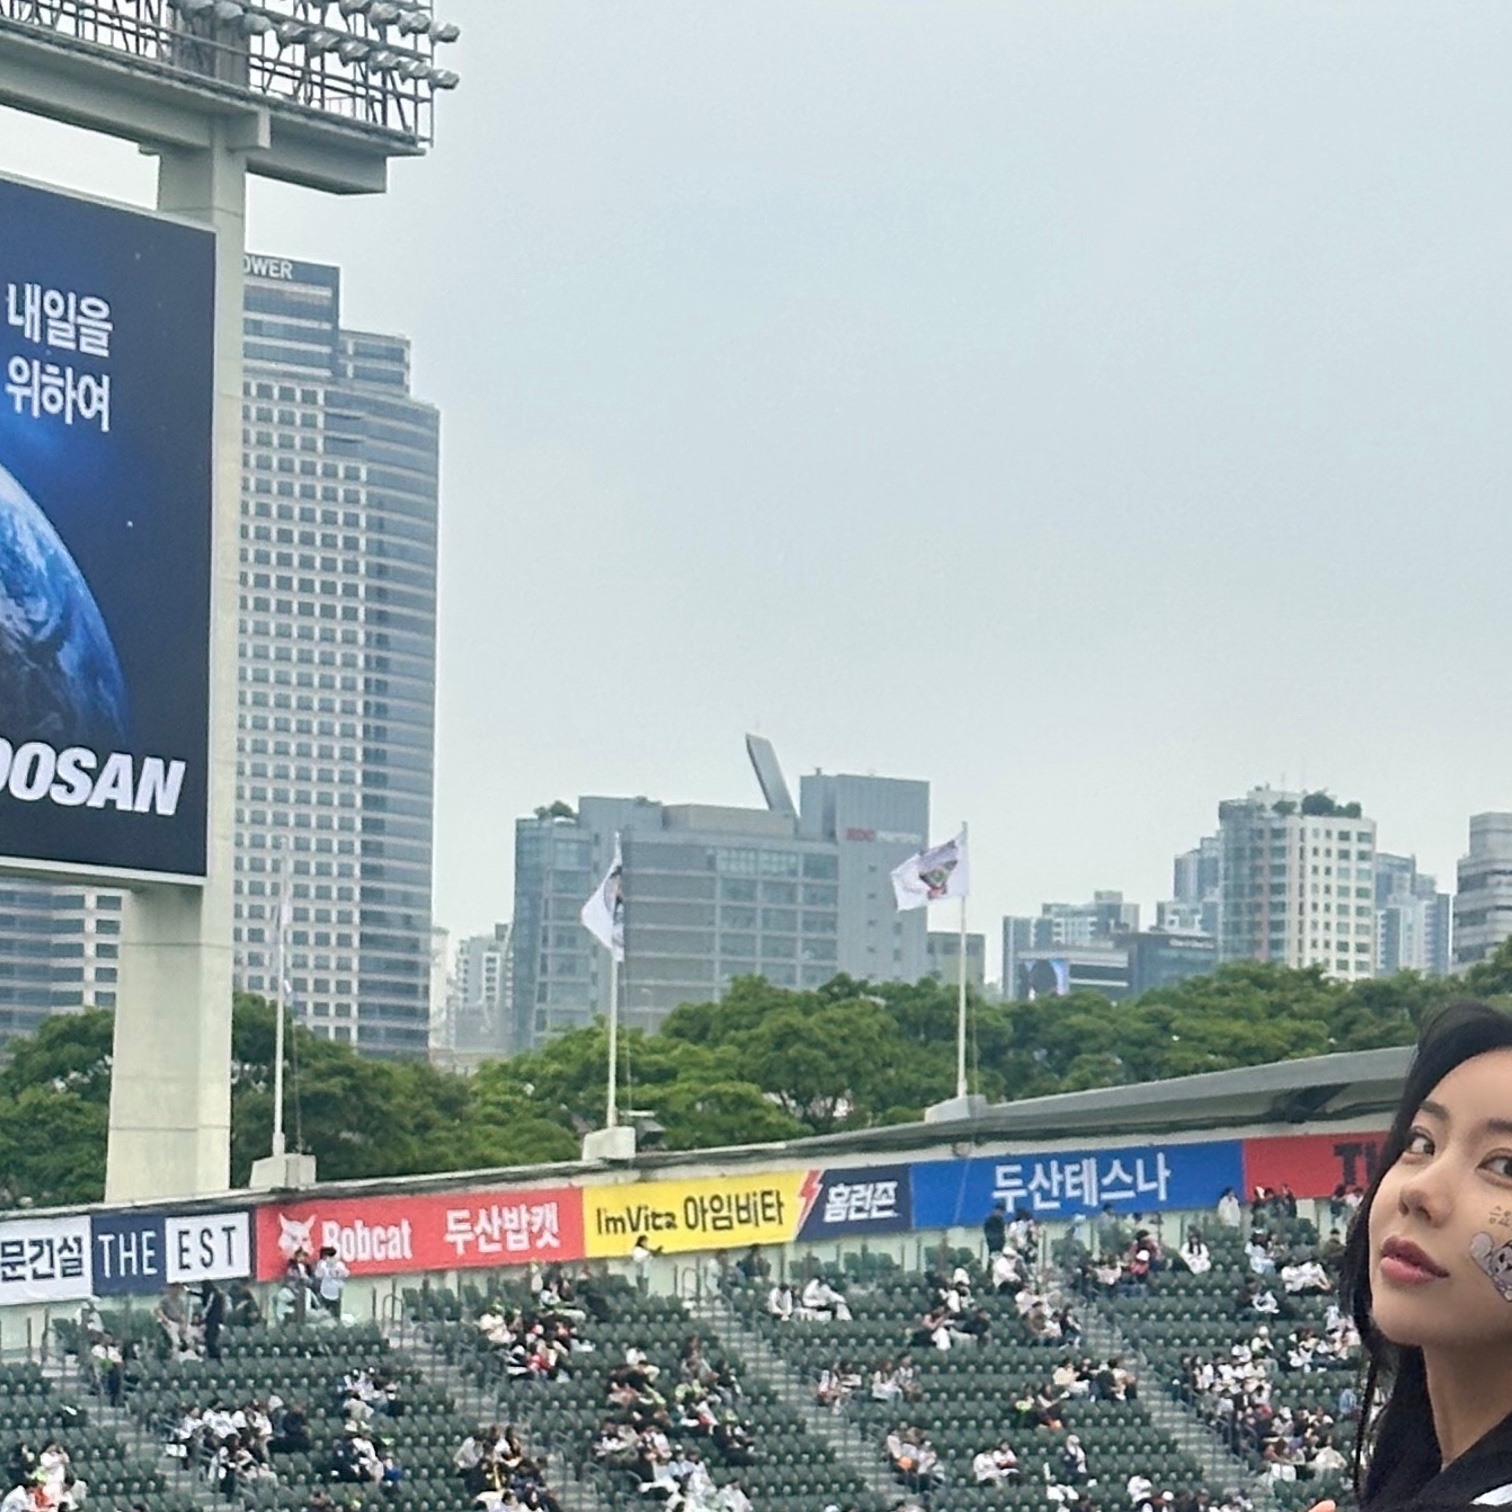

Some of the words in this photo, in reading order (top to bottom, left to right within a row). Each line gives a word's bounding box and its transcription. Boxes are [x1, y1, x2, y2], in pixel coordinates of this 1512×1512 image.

[7, 283, 113, 357] 내일을
[5, 355, 110, 433] 위하여
[0, 737, 186, 816] OSAN
[823, 1182, 900, 1222] 홈런존
[992, 1152, 1171, 1213] 두산테스나
[444, 1202, 561, 1255] 두산밥캣
[683, 1190, 784, 1232] 아임비타
[98, 1230, 158, 1278] THE
[178, 1226, 236, 1270] EST
[321, 1218, 413, 1262] Bobcat
